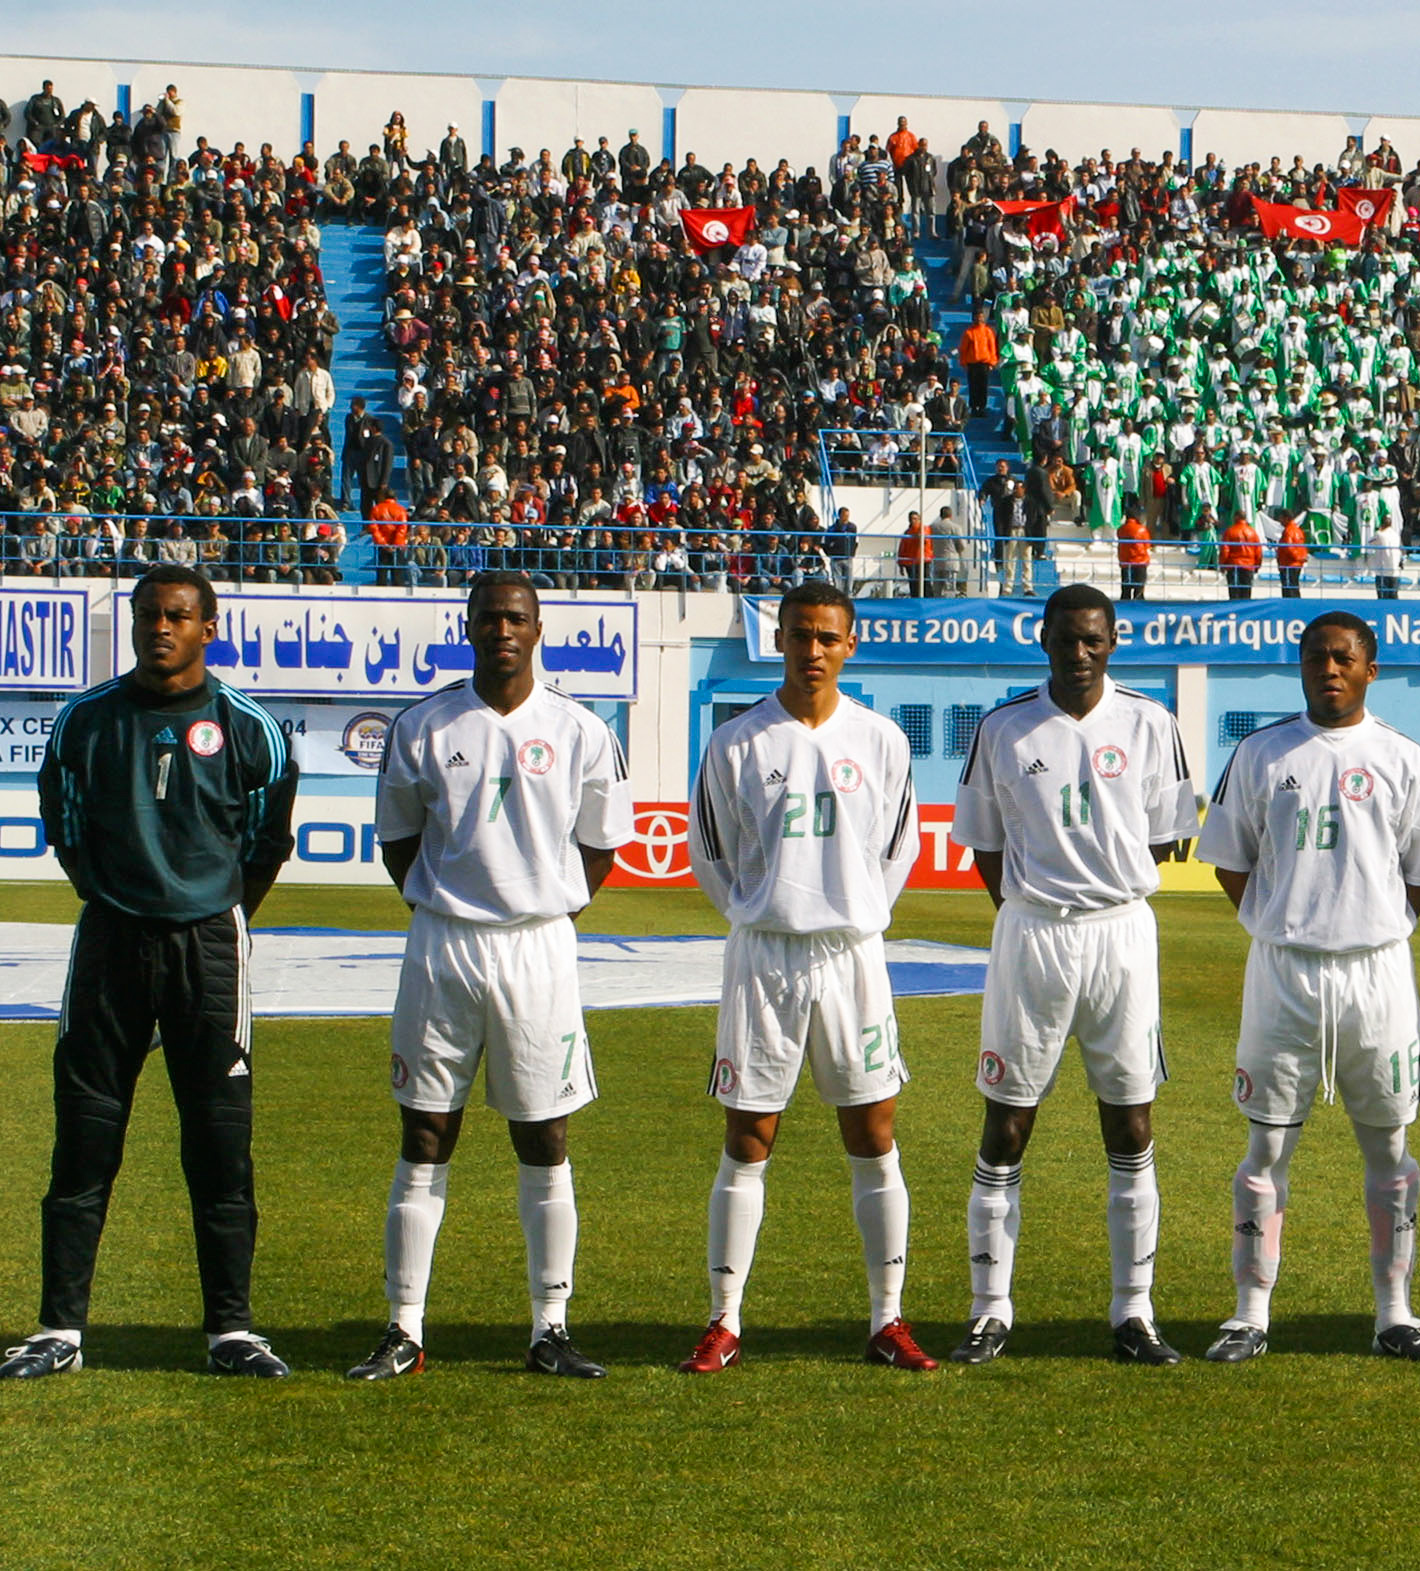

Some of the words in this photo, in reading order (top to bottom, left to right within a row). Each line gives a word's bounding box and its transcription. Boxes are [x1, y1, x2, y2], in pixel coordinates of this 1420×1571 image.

[0, 600, 75, 677] ASTIR
[274, 608, 353, 683] جنات
[853, 619, 919, 643] ISIE
[924, 618, 998, 644] 2004
[365, 626, 400, 685] بن
[22, 717, 54, 735] CE
[10, 745, 45, 763] FIF
[156, 752, 173, 800] 1
[488, 777, 512, 823] 7
[783, 791, 836, 838] 20
[1060, 781, 1090, 827] 11
[1296, 805, 1339, 851] 16
[562, 1033, 578, 1081] 7
